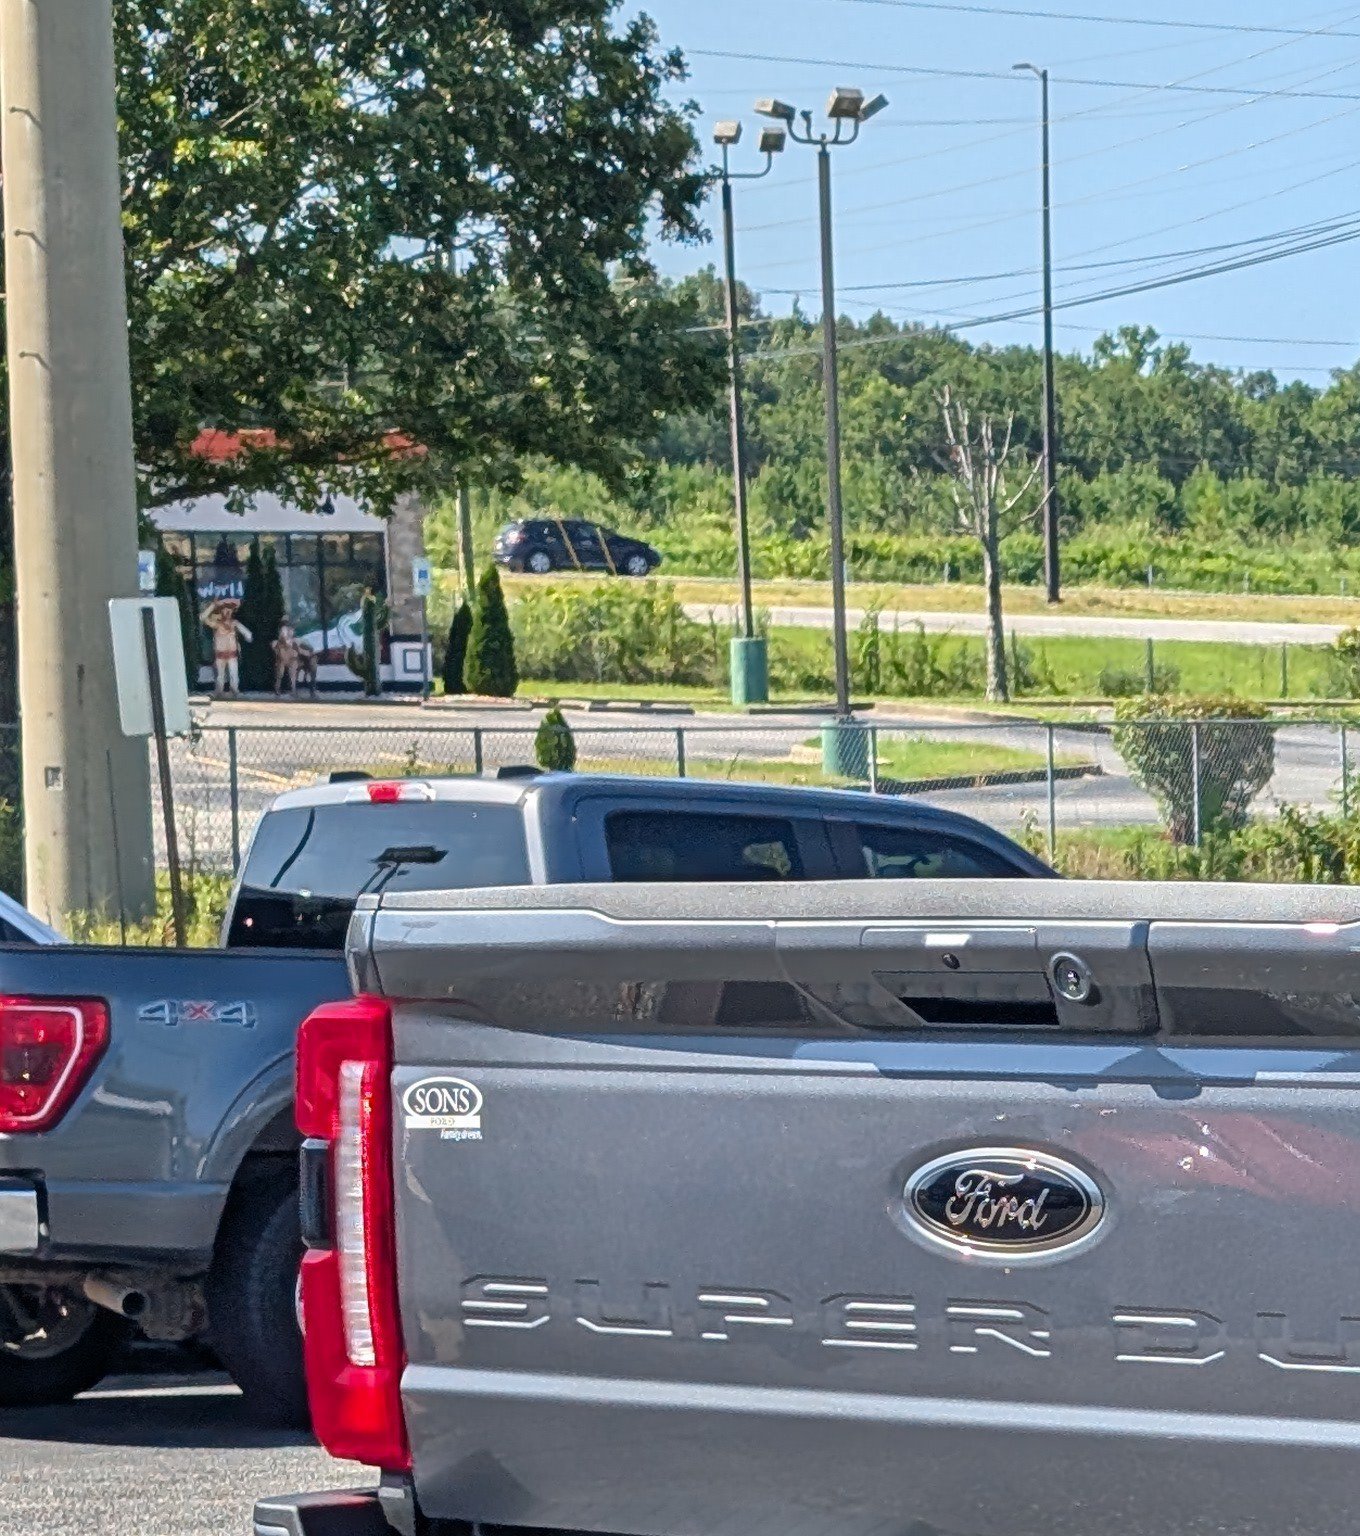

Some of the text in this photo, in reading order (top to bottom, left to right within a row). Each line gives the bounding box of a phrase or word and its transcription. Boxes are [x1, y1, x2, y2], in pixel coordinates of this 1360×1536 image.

[413, 1088, 469, 1113] SONS
[945, 1169, 1050, 1230] Ford
[460, 1273, 1052, 1358] SUPER
